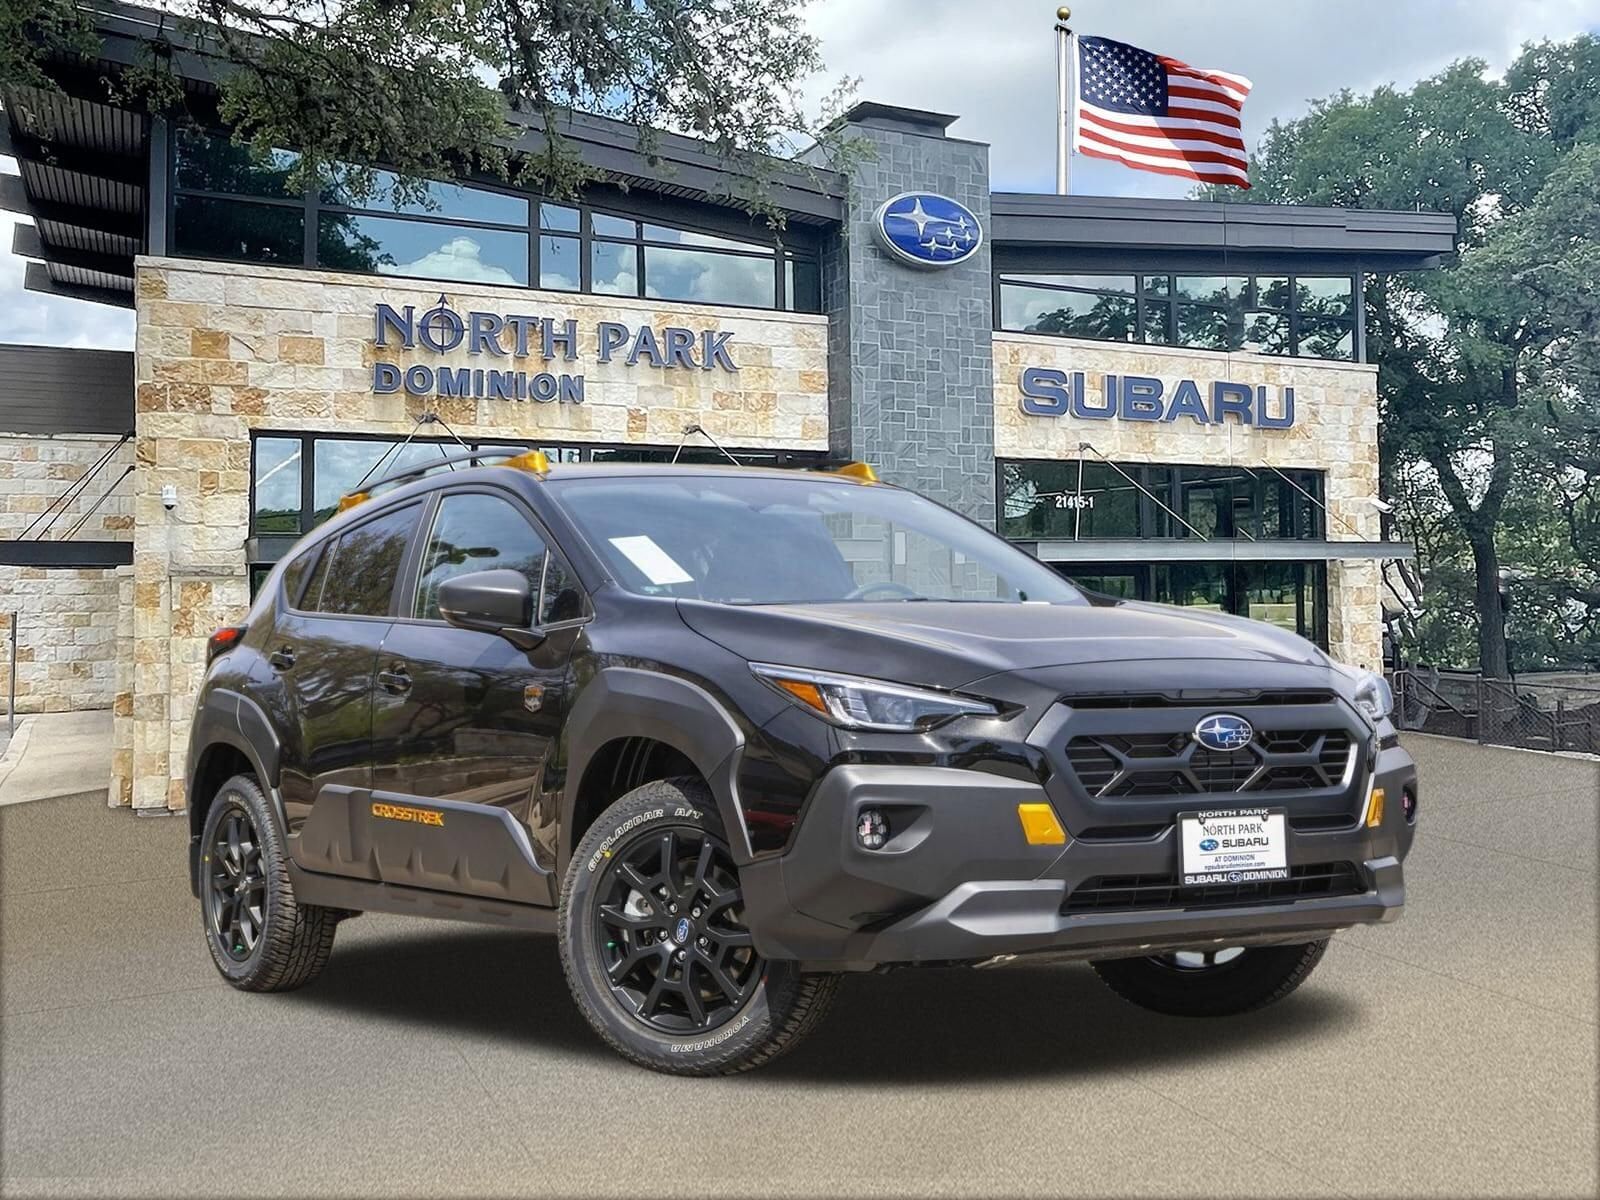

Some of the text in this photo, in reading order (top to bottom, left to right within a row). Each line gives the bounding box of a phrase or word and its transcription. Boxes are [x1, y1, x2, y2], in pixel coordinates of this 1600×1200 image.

[375, 296, 740, 373] NORTH PARK
[373, 361, 585, 404] DOMINION
[1019, 366, 1295, 430] SUBARU
[372, 802, 444, 827] CROSSTREK
[1198, 808, 1269, 818] NORTH PARK
[588, 806, 703, 872] GEOLANDAR A/T
[1202, 823, 1264, 837] NORTH PARK
[1222, 837, 1269, 848] SUBARU
[1214, 854, 1255, 863] AT DOMINION
[1184, 869, 1288, 885] SUBARU DOMINION
[670, 1015, 750, 1053] YOKOHAMA
